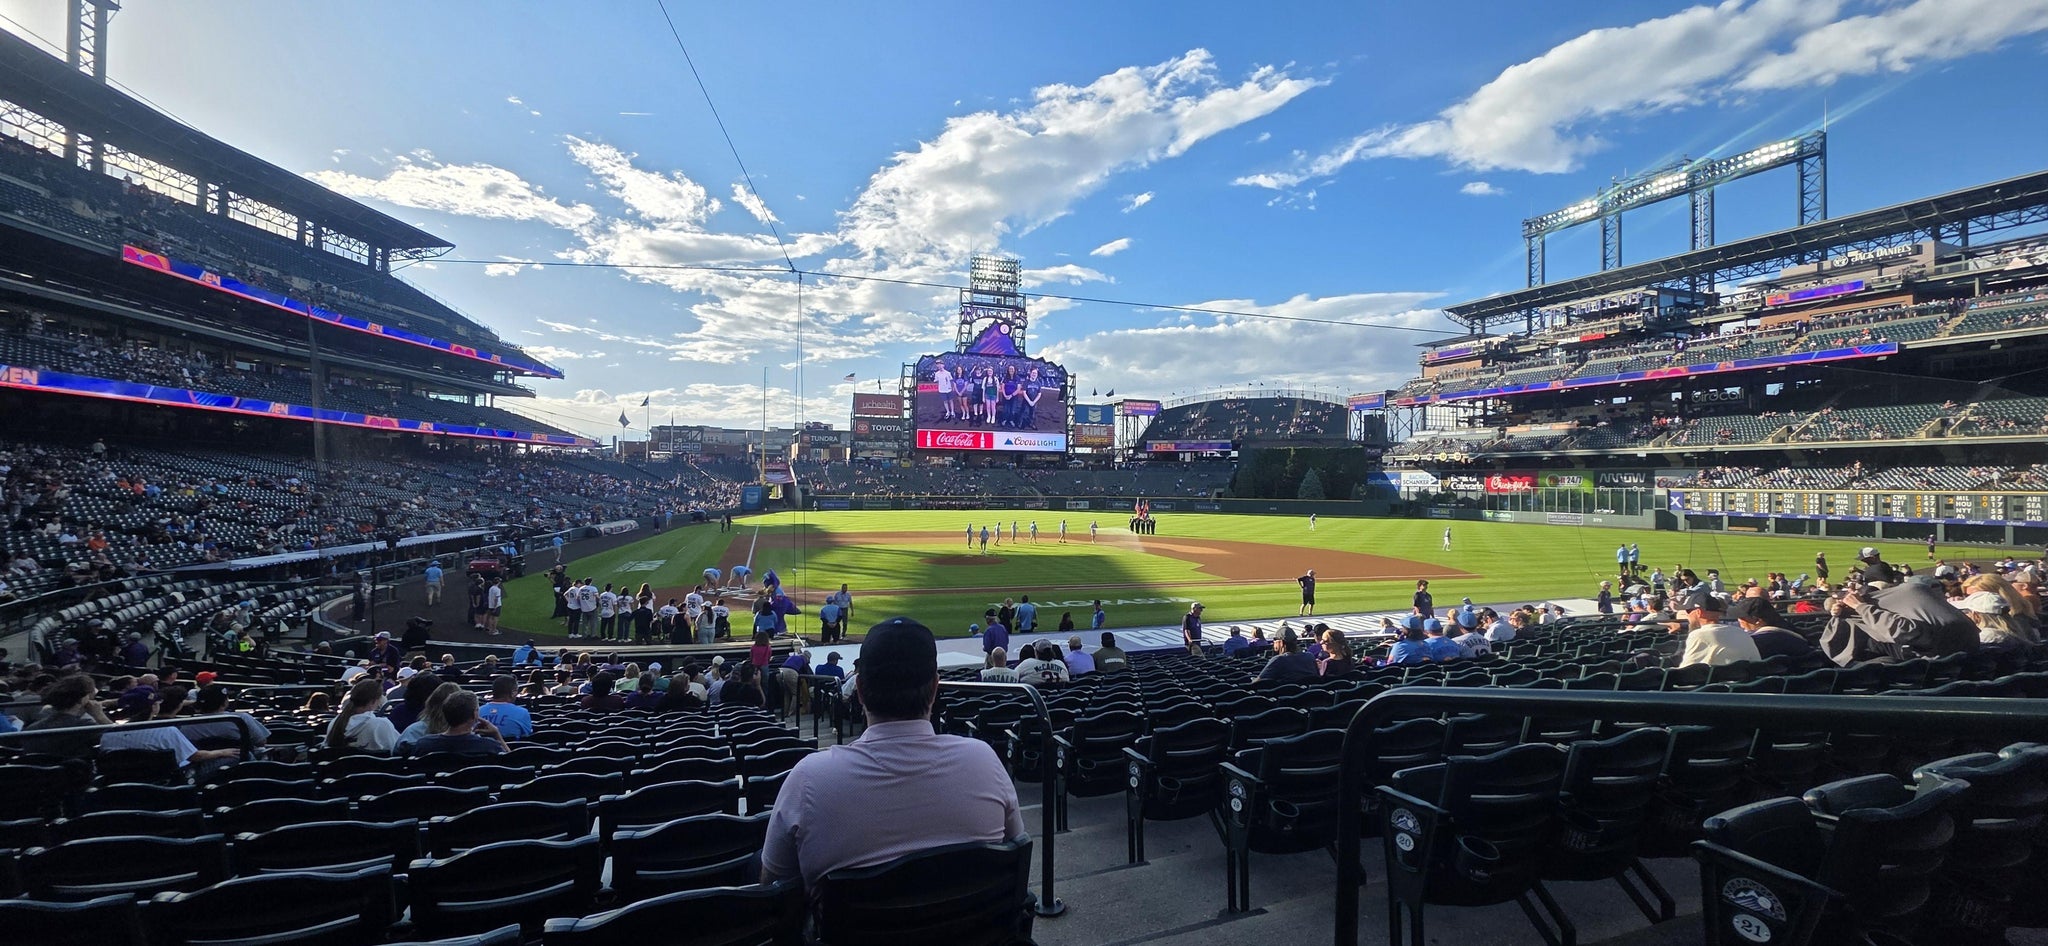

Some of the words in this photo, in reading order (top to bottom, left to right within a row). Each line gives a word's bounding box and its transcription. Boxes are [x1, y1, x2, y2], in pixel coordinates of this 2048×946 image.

[1852, 250, 1875, 262] JACK
[871, 424, 902, 432] TOYOTA
[1450, 482, 1484, 490] Colorado
[1398, 836, 1412, 848] 20
[1740, 919, 1762, 938] 21
